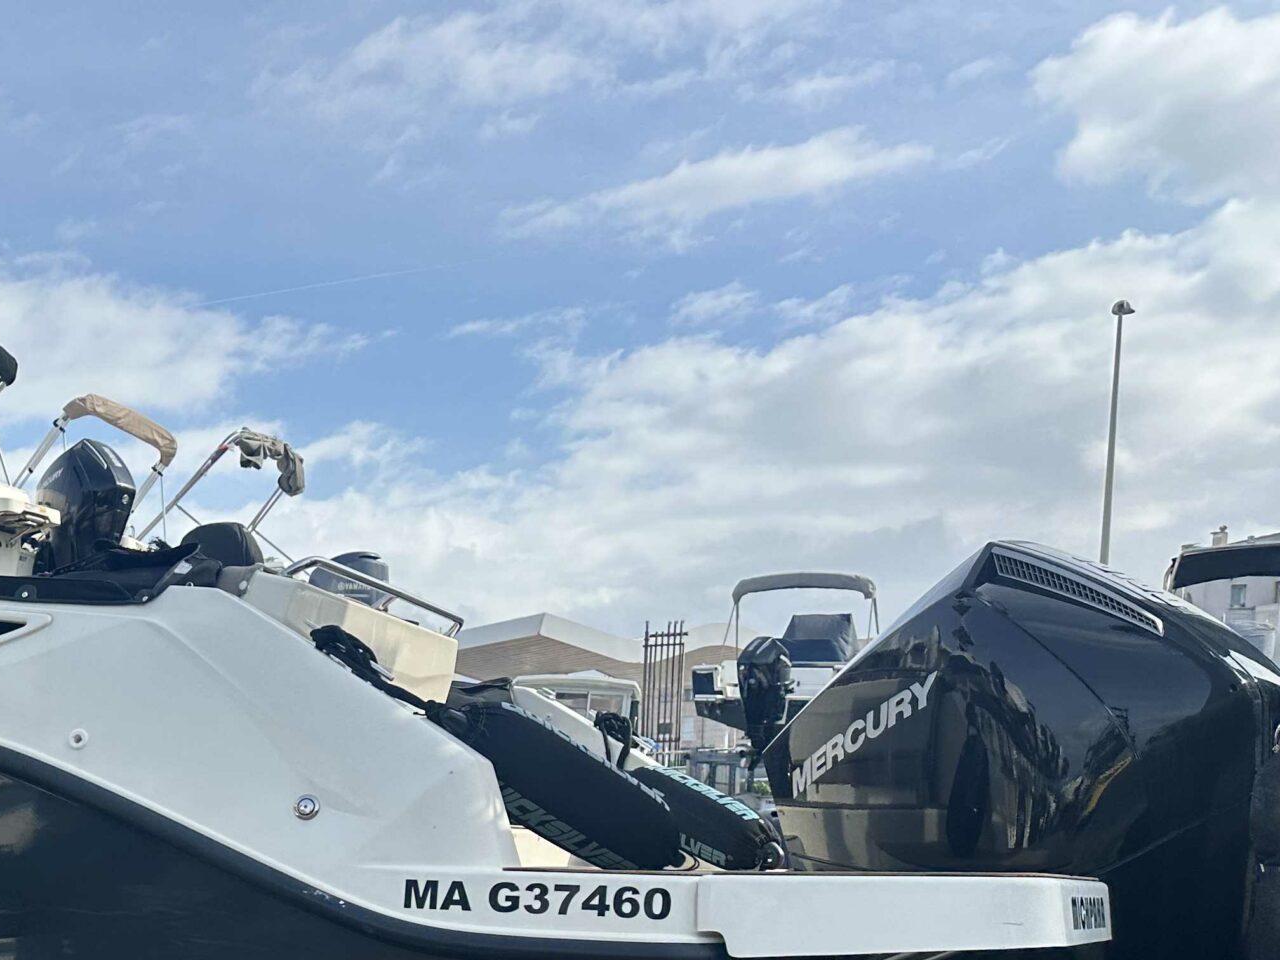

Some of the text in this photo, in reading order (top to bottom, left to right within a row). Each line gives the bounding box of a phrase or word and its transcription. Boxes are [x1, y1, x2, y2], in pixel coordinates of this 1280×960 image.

[792, 670, 938, 800] MERCURY
[403, 879, 672, 921] MA G37460
